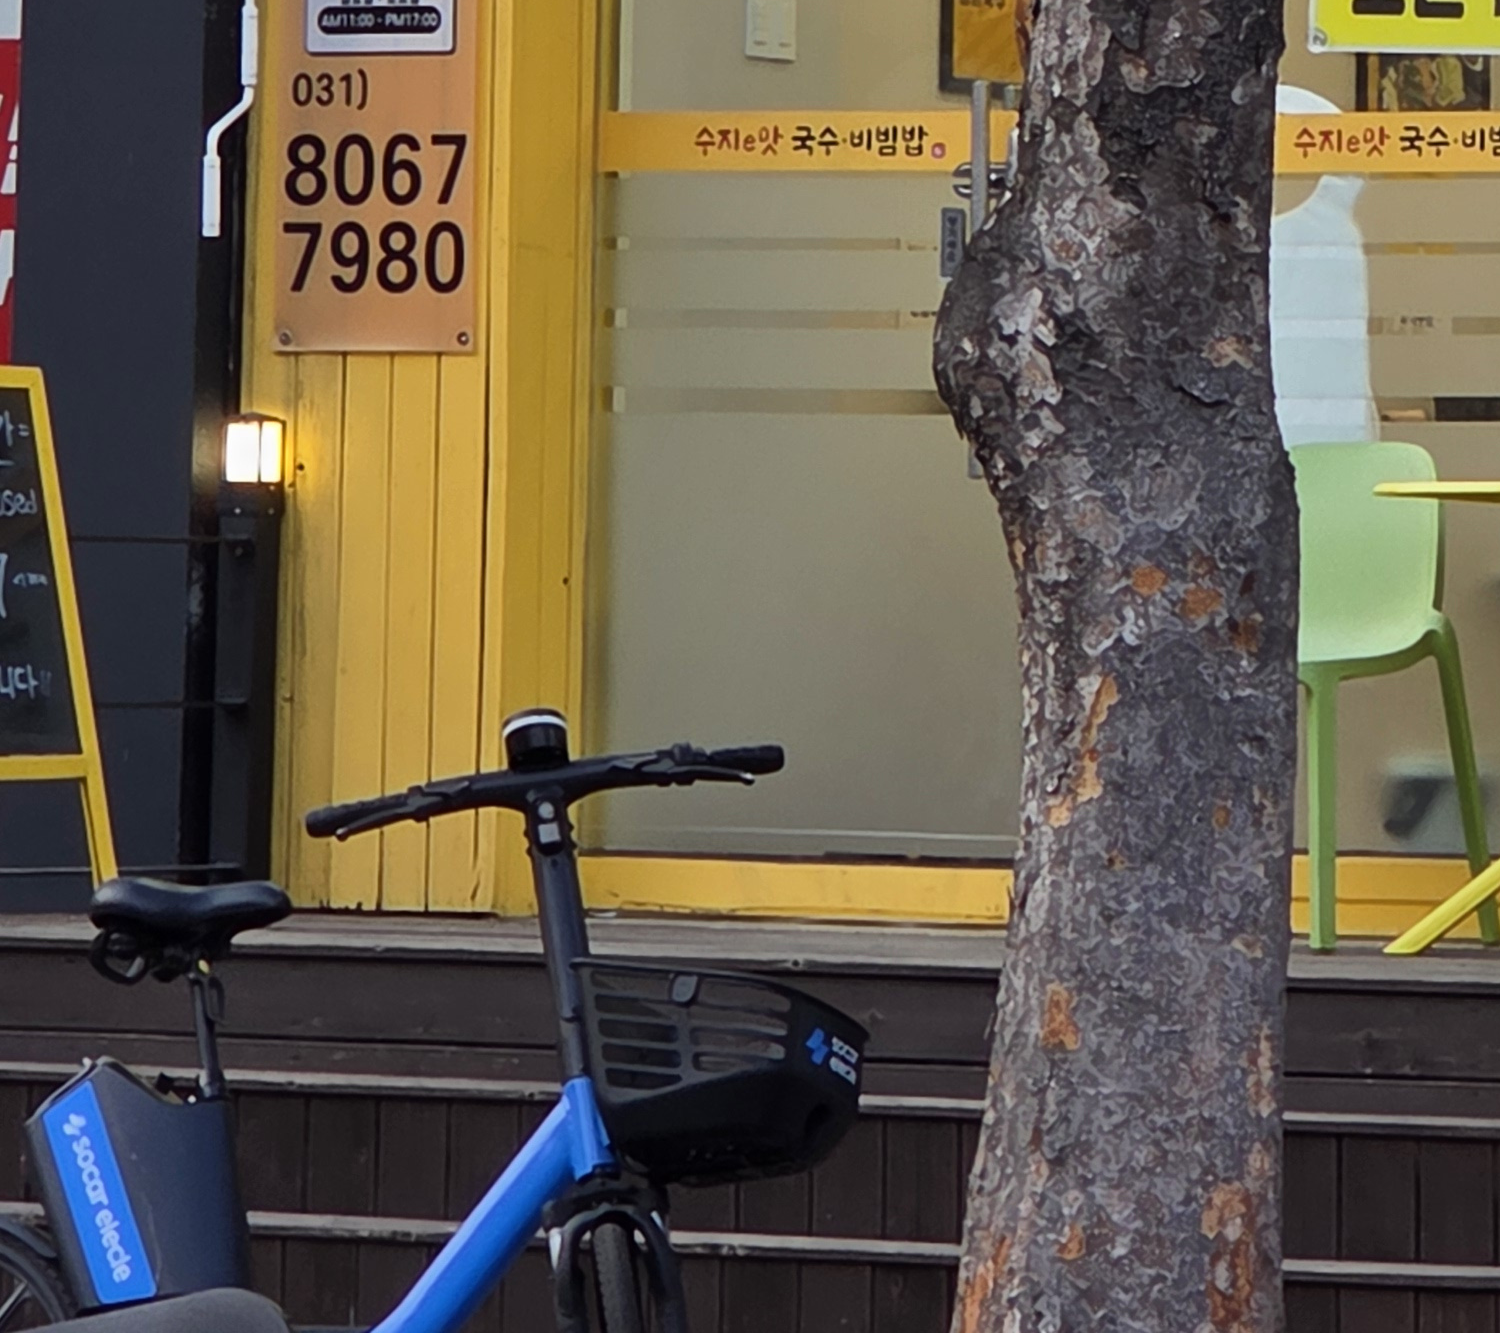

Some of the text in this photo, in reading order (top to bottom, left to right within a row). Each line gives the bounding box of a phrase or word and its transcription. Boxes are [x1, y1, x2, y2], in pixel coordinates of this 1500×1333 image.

[292, 69, 368, 110] 031)
[284, 133, 467, 206] 8067
[694, 126, 784, 158] 수지e맛
[1294, 126, 1391, 158] 수지e맛
[281, 221, 465, 294] 7980
[72, 1136, 109, 1206] socar
